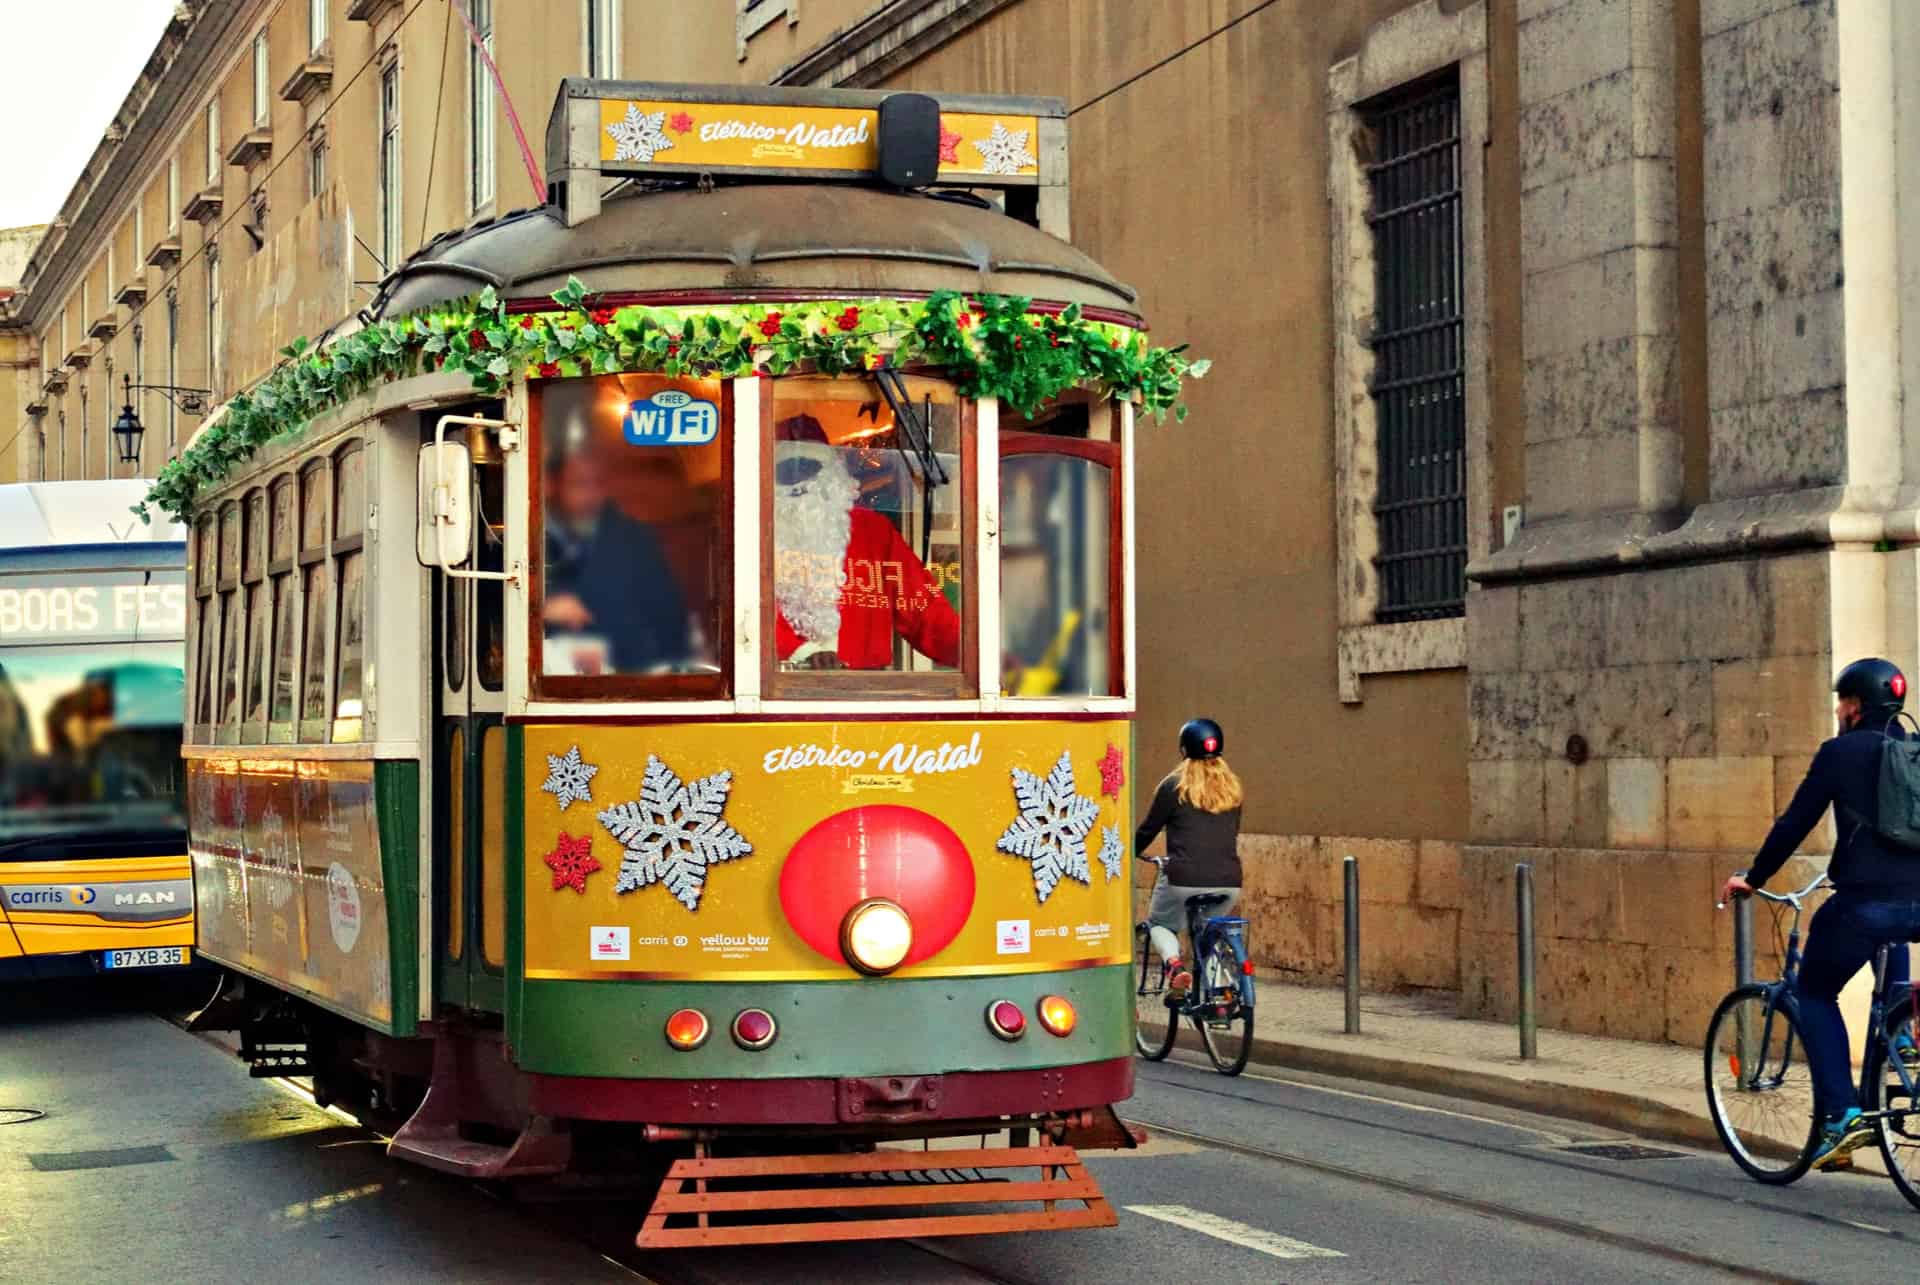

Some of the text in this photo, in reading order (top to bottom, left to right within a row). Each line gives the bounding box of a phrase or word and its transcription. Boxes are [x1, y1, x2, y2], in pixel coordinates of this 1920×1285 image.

[658, 394, 684, 405] FREE
[0, 587, 99, 632] BOAS
[11, 888, 175, 905] carris MAN
